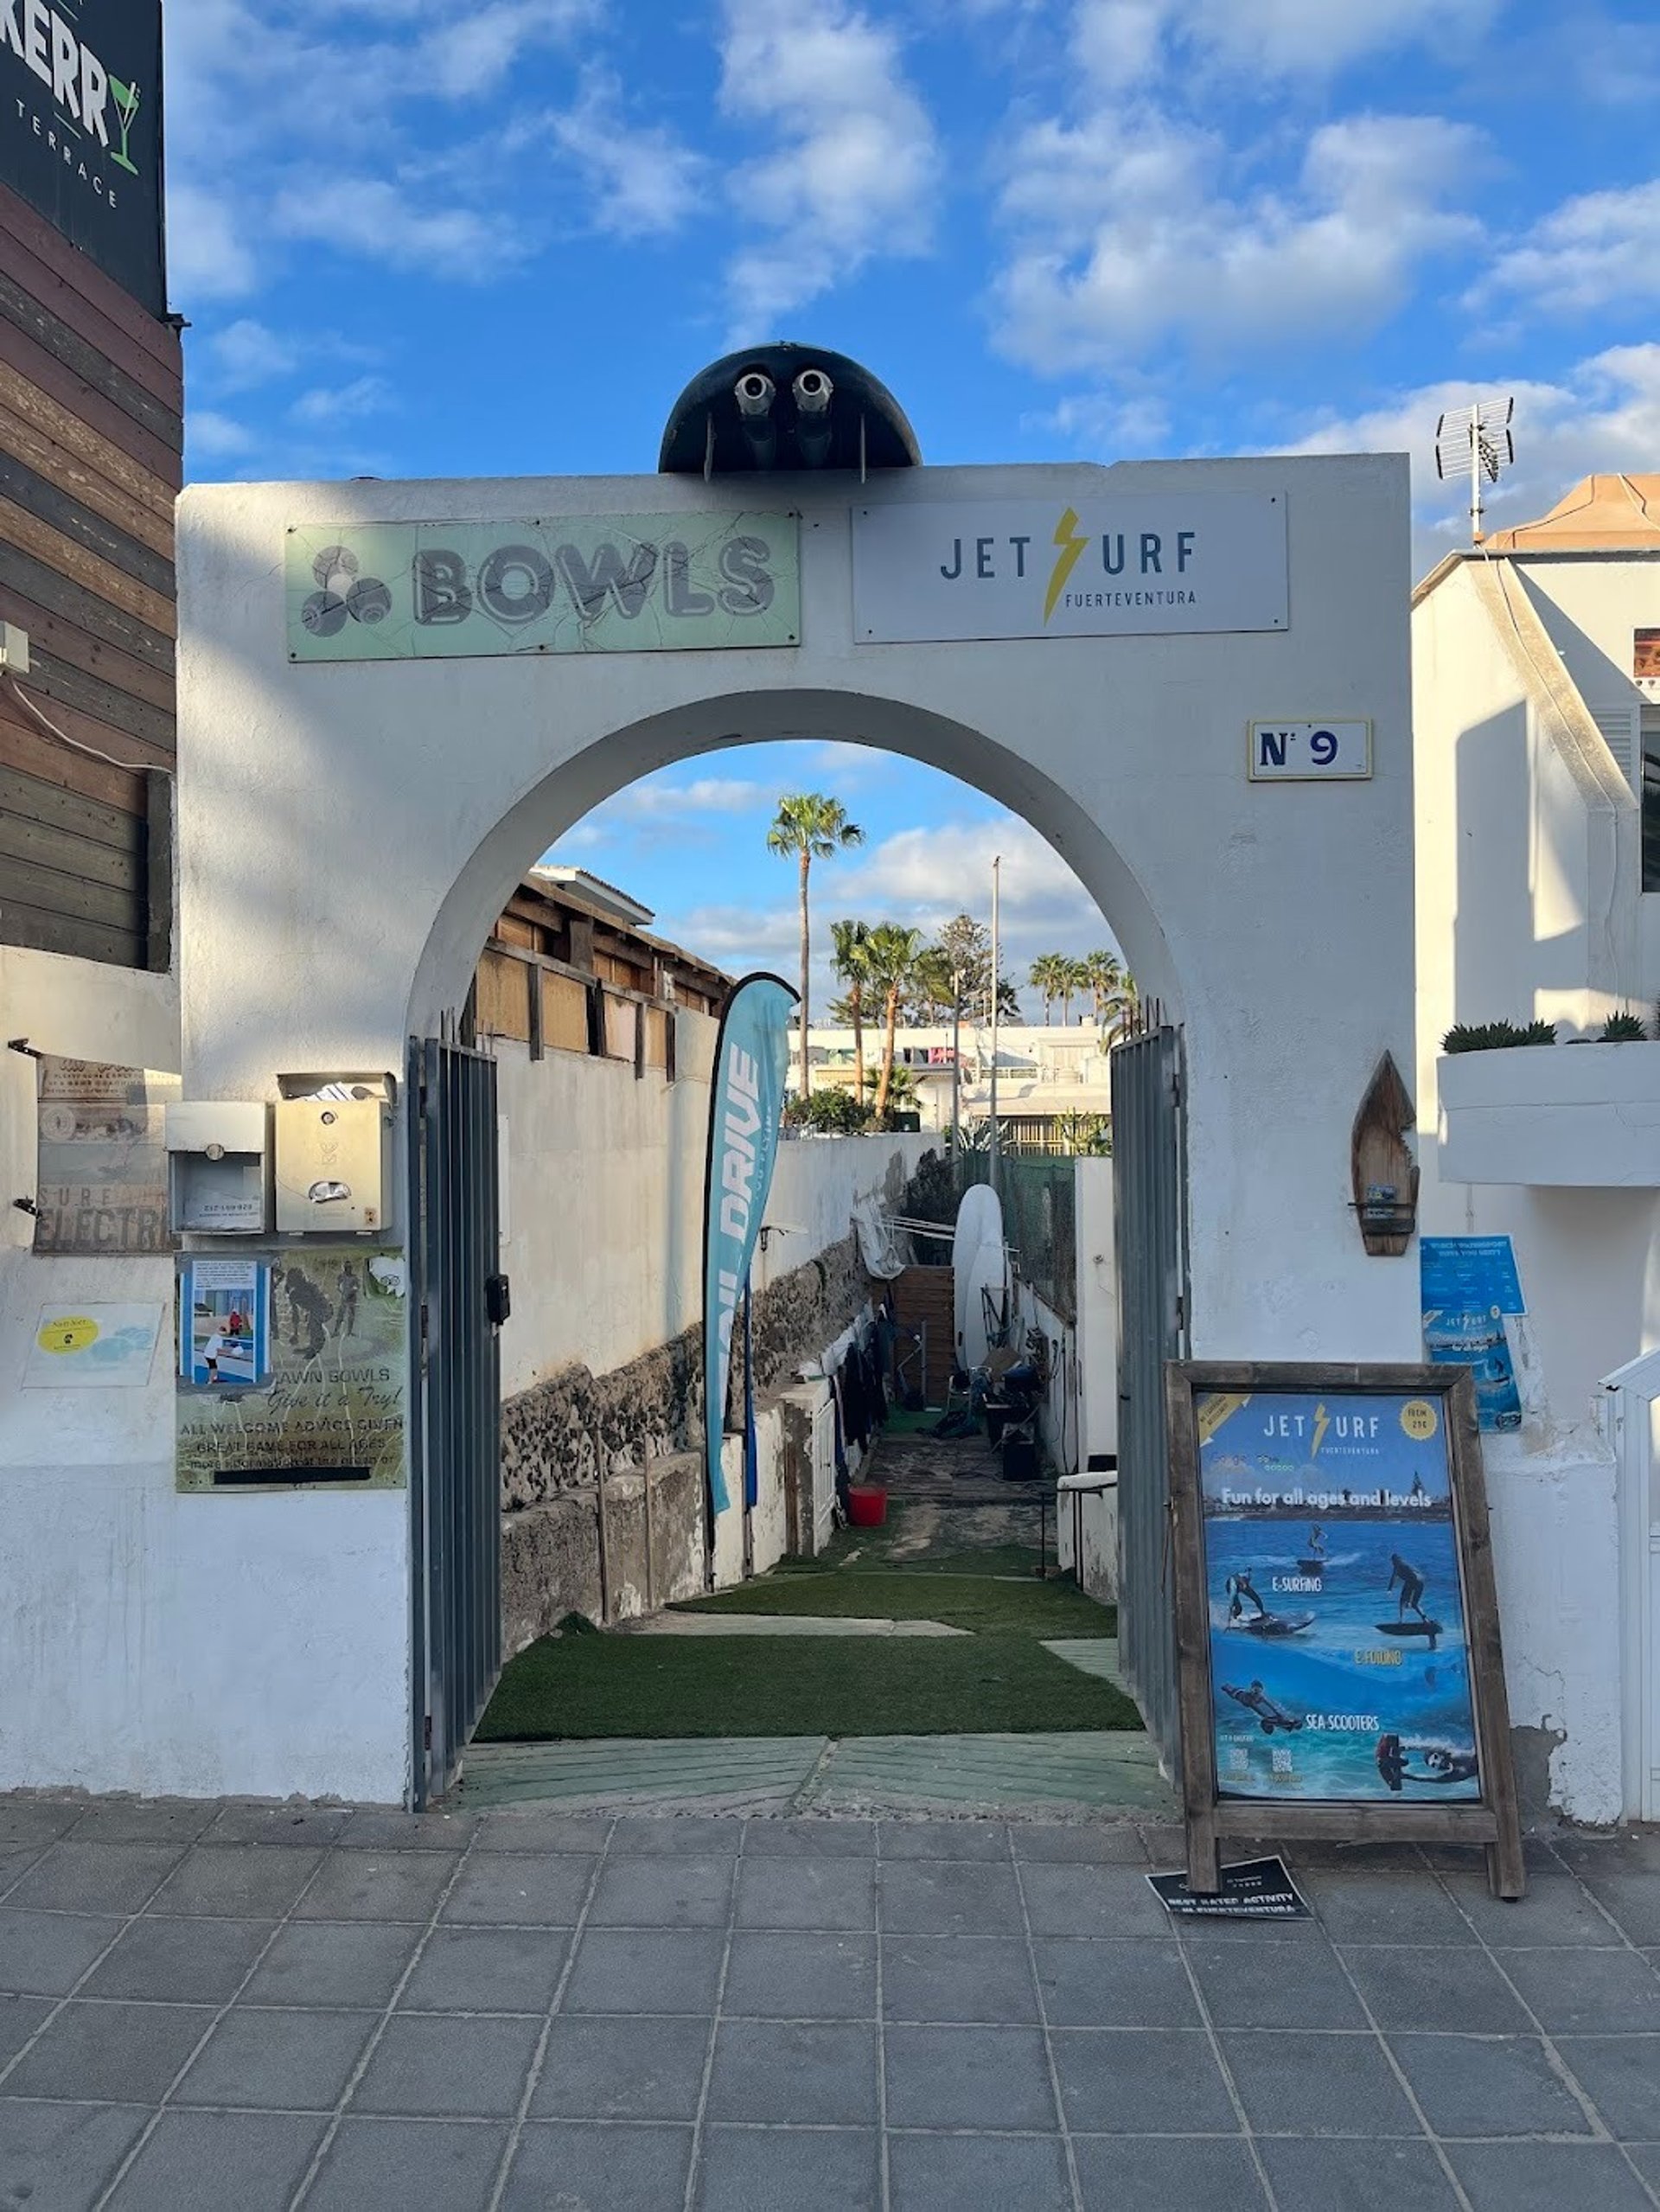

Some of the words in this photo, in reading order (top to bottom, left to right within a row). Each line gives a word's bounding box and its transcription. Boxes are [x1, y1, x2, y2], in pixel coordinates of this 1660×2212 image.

[16, 98, 118, 208] TERRACE
[940, 536, 1031, 580] JET
[412, 535, 776, 626] BOWLS
[1064, 591, 1197, 608] FUERTEVENTURA
[1310, 730, 1338, 766] 9
[720, 1041, 759, 1245] DRIVE
[276, 1370, 322, 1384] AWN
[329, 1368, 390, 1383] BOWLS
[267, 1388, 308, 1416] Give
[315, 1392, 331, 1408] it
[337, 1395, 350, 1406] a
[358, 1385, 404, 1410] Try!
[180, 1423, 207, 1435] ALL
[210, 1422, 288, 1435] WELCOME
[295, 1419, 351, 1432] ADVICE
[357, 1418, 404, 1431] GIVEN
[1263, 1414, 1306, 1437] JET
[196, 1441, 240, 1454] GREAT
[289, 1440, 316, 1452] FOR
[319, 1439, 346, 1450] ALL
[1222, 1486, 1253, 1505] Fun
[1254, 1486, 1278, 1505] for
[1282, 1487, 1304, 1506] all
[1306, 1492, 1345, 1509] ages
[1349, 1489, 1382, 1507] and
[1383, 1489, 1433, 1508] levels
[1272, 1576, 1324, 1593] E-SURFING
[1306, 1714, 1326, 1730] SEA
[1327, 1714, 1381, 1731] SCOOTERS
[1243, 1893, 1294, 1905] ACTIVITY
